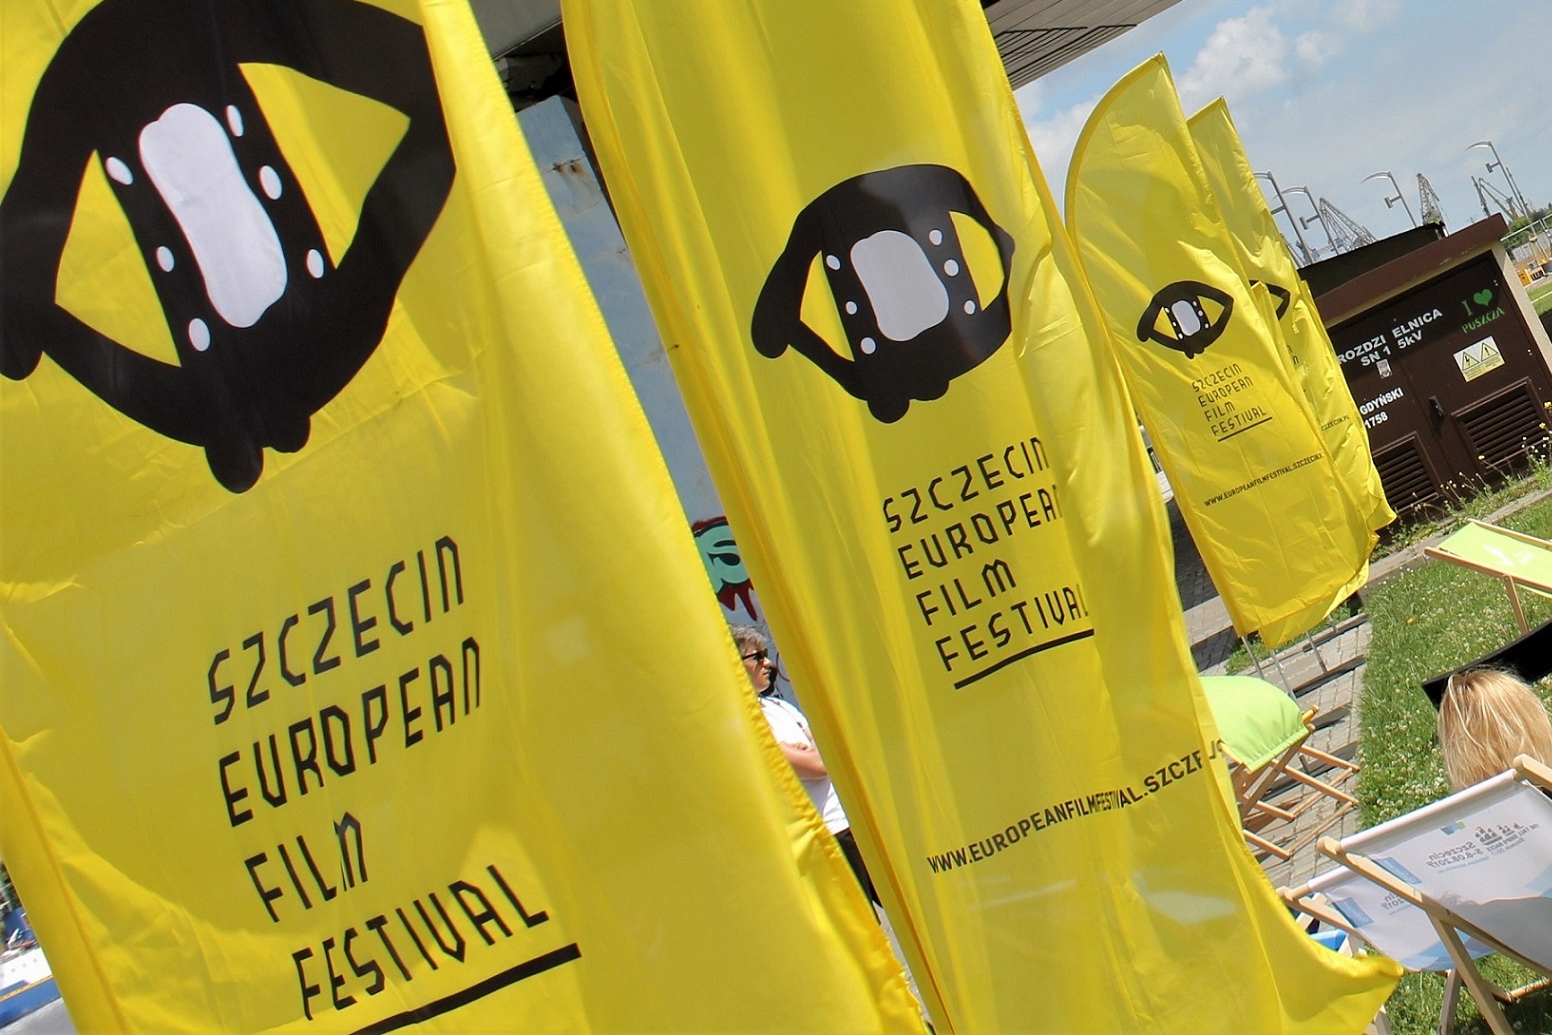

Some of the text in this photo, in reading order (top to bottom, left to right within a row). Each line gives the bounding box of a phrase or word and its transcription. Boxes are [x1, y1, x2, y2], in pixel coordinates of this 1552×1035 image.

[1391, 308, 1443, 339] ELNICA
[1360, 351, 1381, 367] SN
[1192, 363, 1243, 392] SZCZECIN
[1198, 376, 1254, 407] EUROPEAN
[1204, 401, 1236, 422] FILM
[1359, 387, 1404, 415] GDYŃSKI
[1211, 405, 1267, 436] FESTIVAL
[883, 436, 1050, 533] SZCZECIN
[916, 558, 1017, 626] FILM
[207, 535, 465, 725] SZCZECIN
[218, 636, 481, 828] EUROPEAN
[244, 811, 369, 923] FILM
[292, 864, 550, 1021] FESTIVAL
